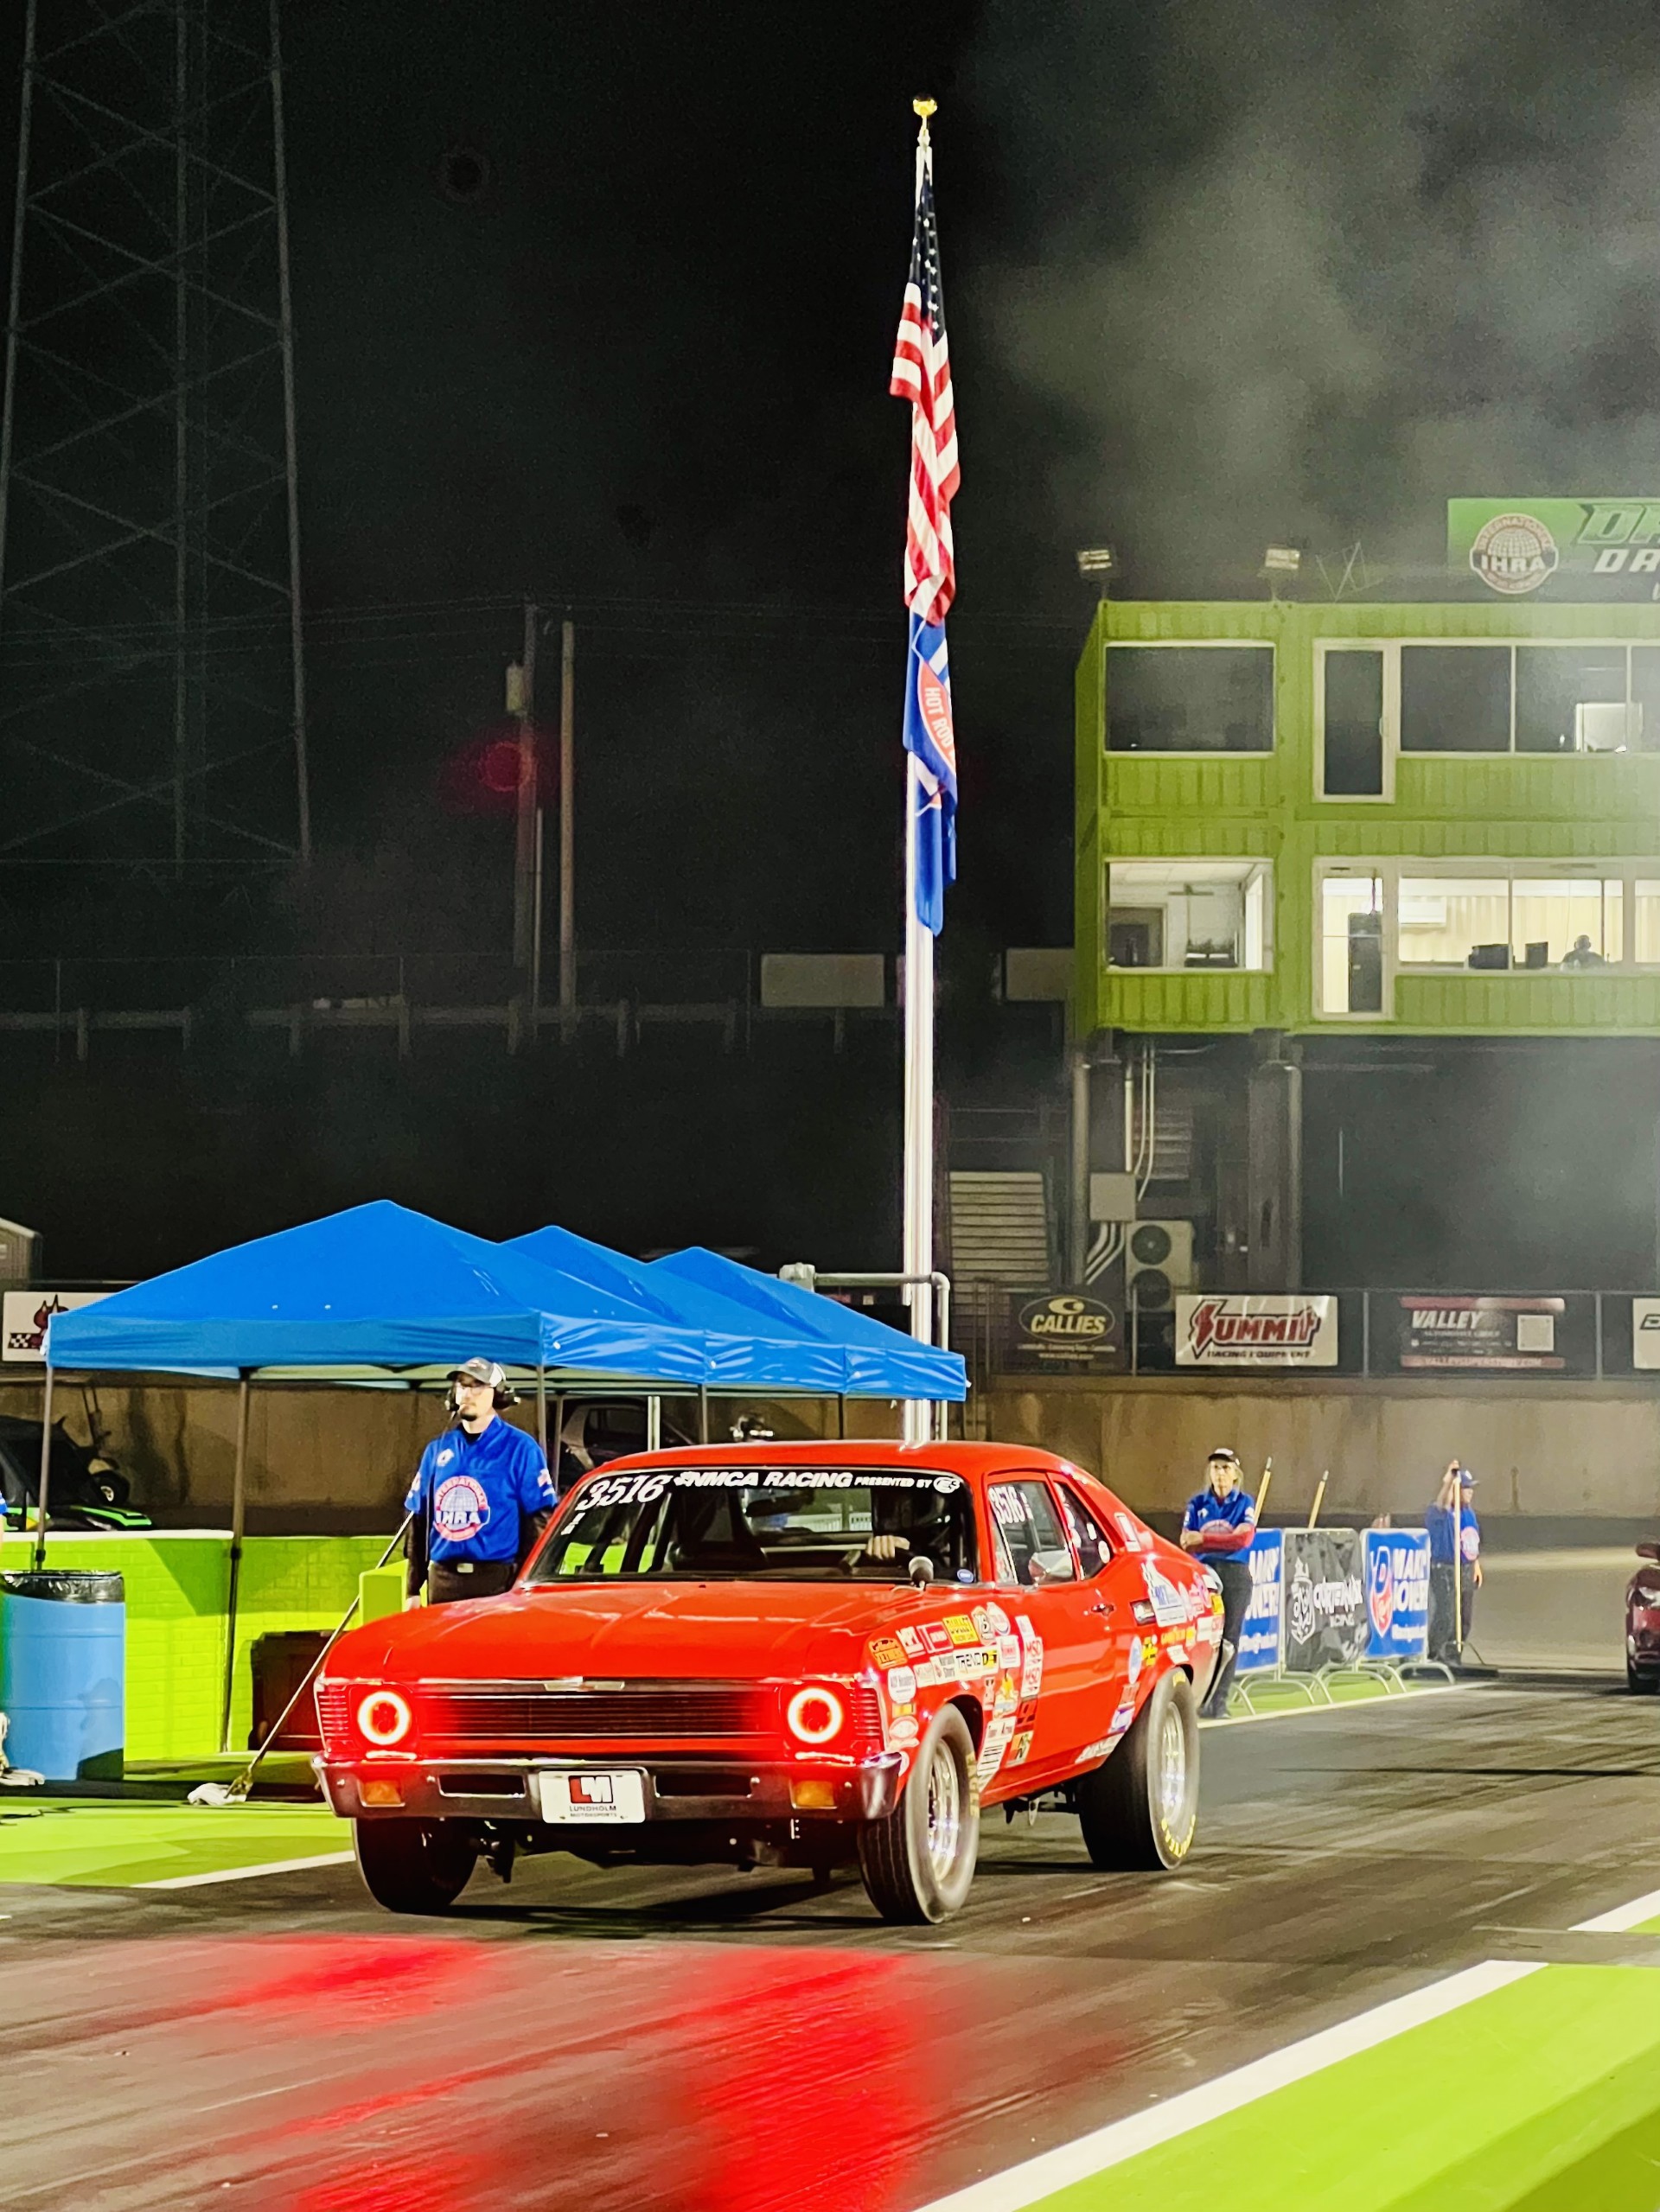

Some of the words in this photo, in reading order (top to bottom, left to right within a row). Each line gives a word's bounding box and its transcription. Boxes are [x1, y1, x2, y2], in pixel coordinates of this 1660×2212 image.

[1480, 554, 1546, 572] IHRA
[924, 687, 944, 715] HOT
[932, 717, 954, 749] ROD
[1031, 1314, 1107, 1334] CALLIES
[1193, 1302, 1317, 1351] SUMMIT
[1412, 1310, 1482, 1329] VALLEY
[575, 1475, 674, 1511] 3516
[688, 1471, 759, 1487] NMCA
[763, 1471, 853, 1488] RACING
[854, 1476, 915, 1488] PRESENTED
[916, 1478, 933, 1488] BY
[988, 1486, 1025, 1524] 3516
